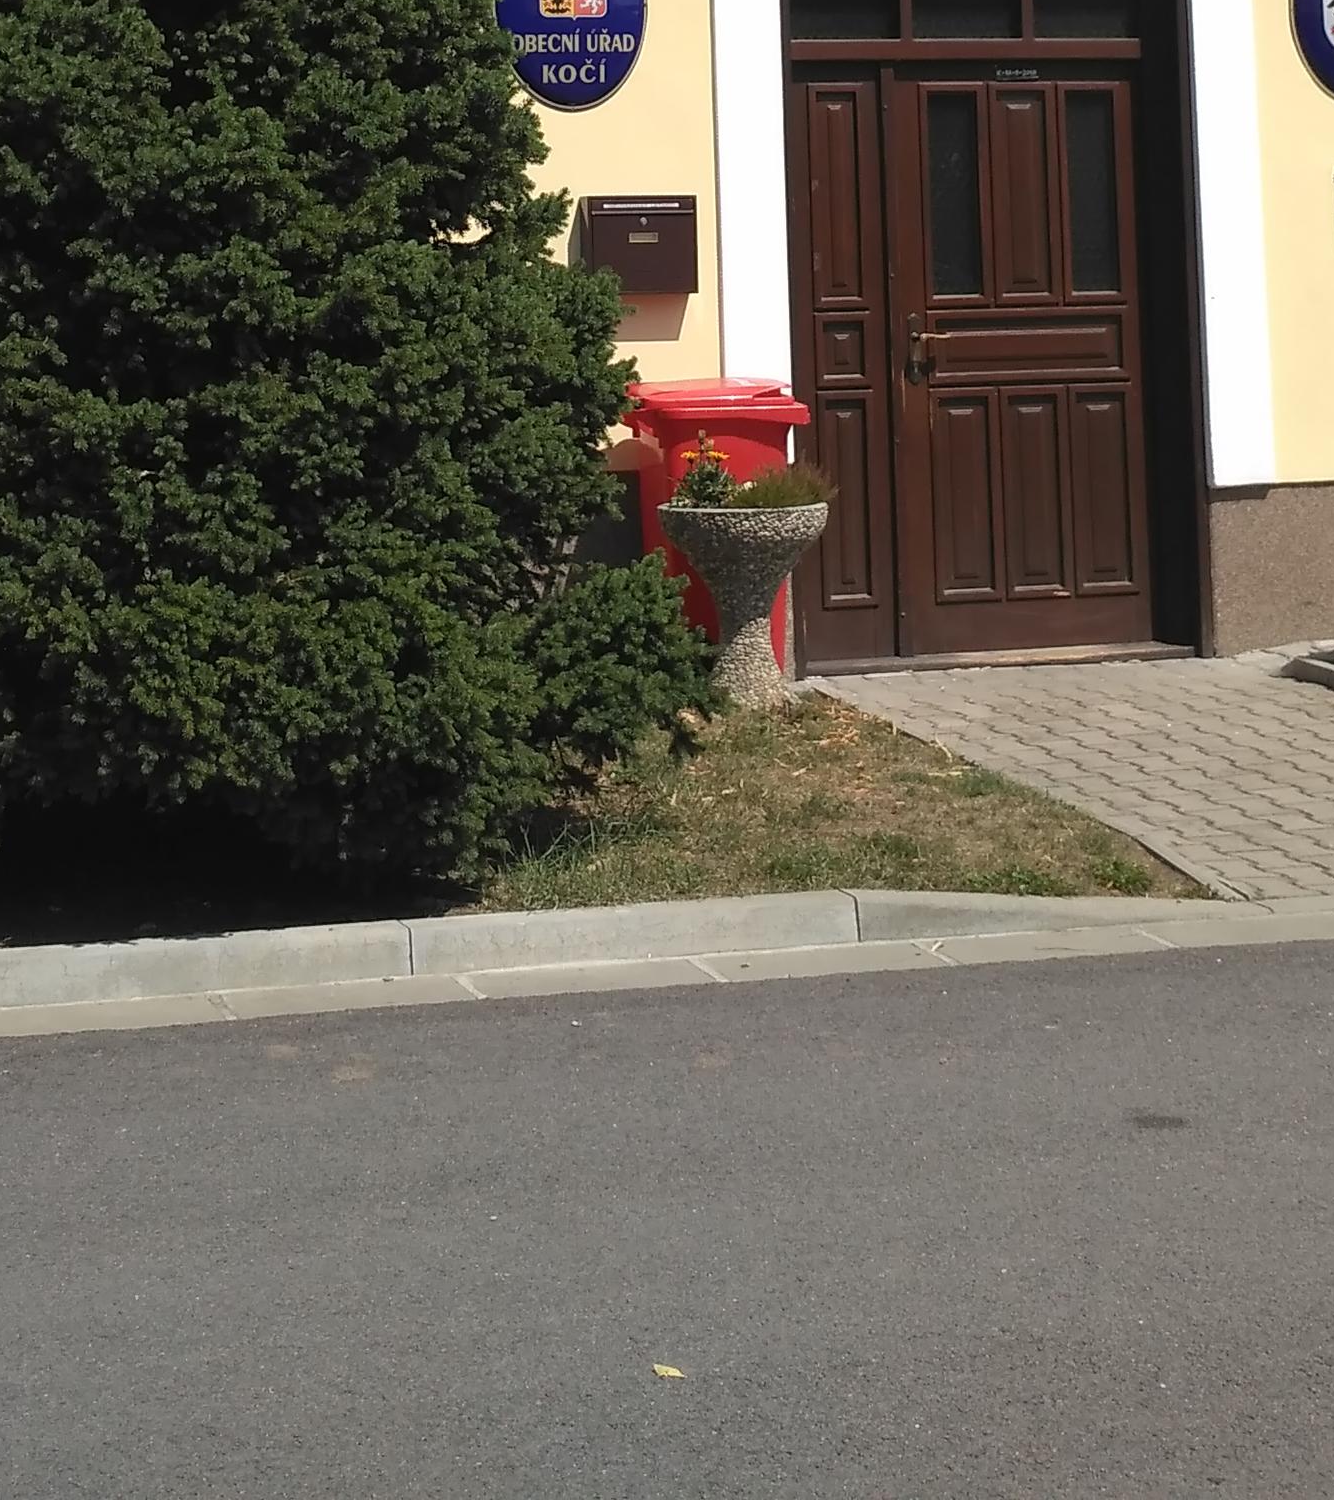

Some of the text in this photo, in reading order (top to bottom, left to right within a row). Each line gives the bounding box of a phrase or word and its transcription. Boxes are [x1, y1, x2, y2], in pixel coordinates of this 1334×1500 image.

[512, 28, 635, 53] OBECNÍ ÚŘAD
[542, 58, 607, 84] KOČÍ
